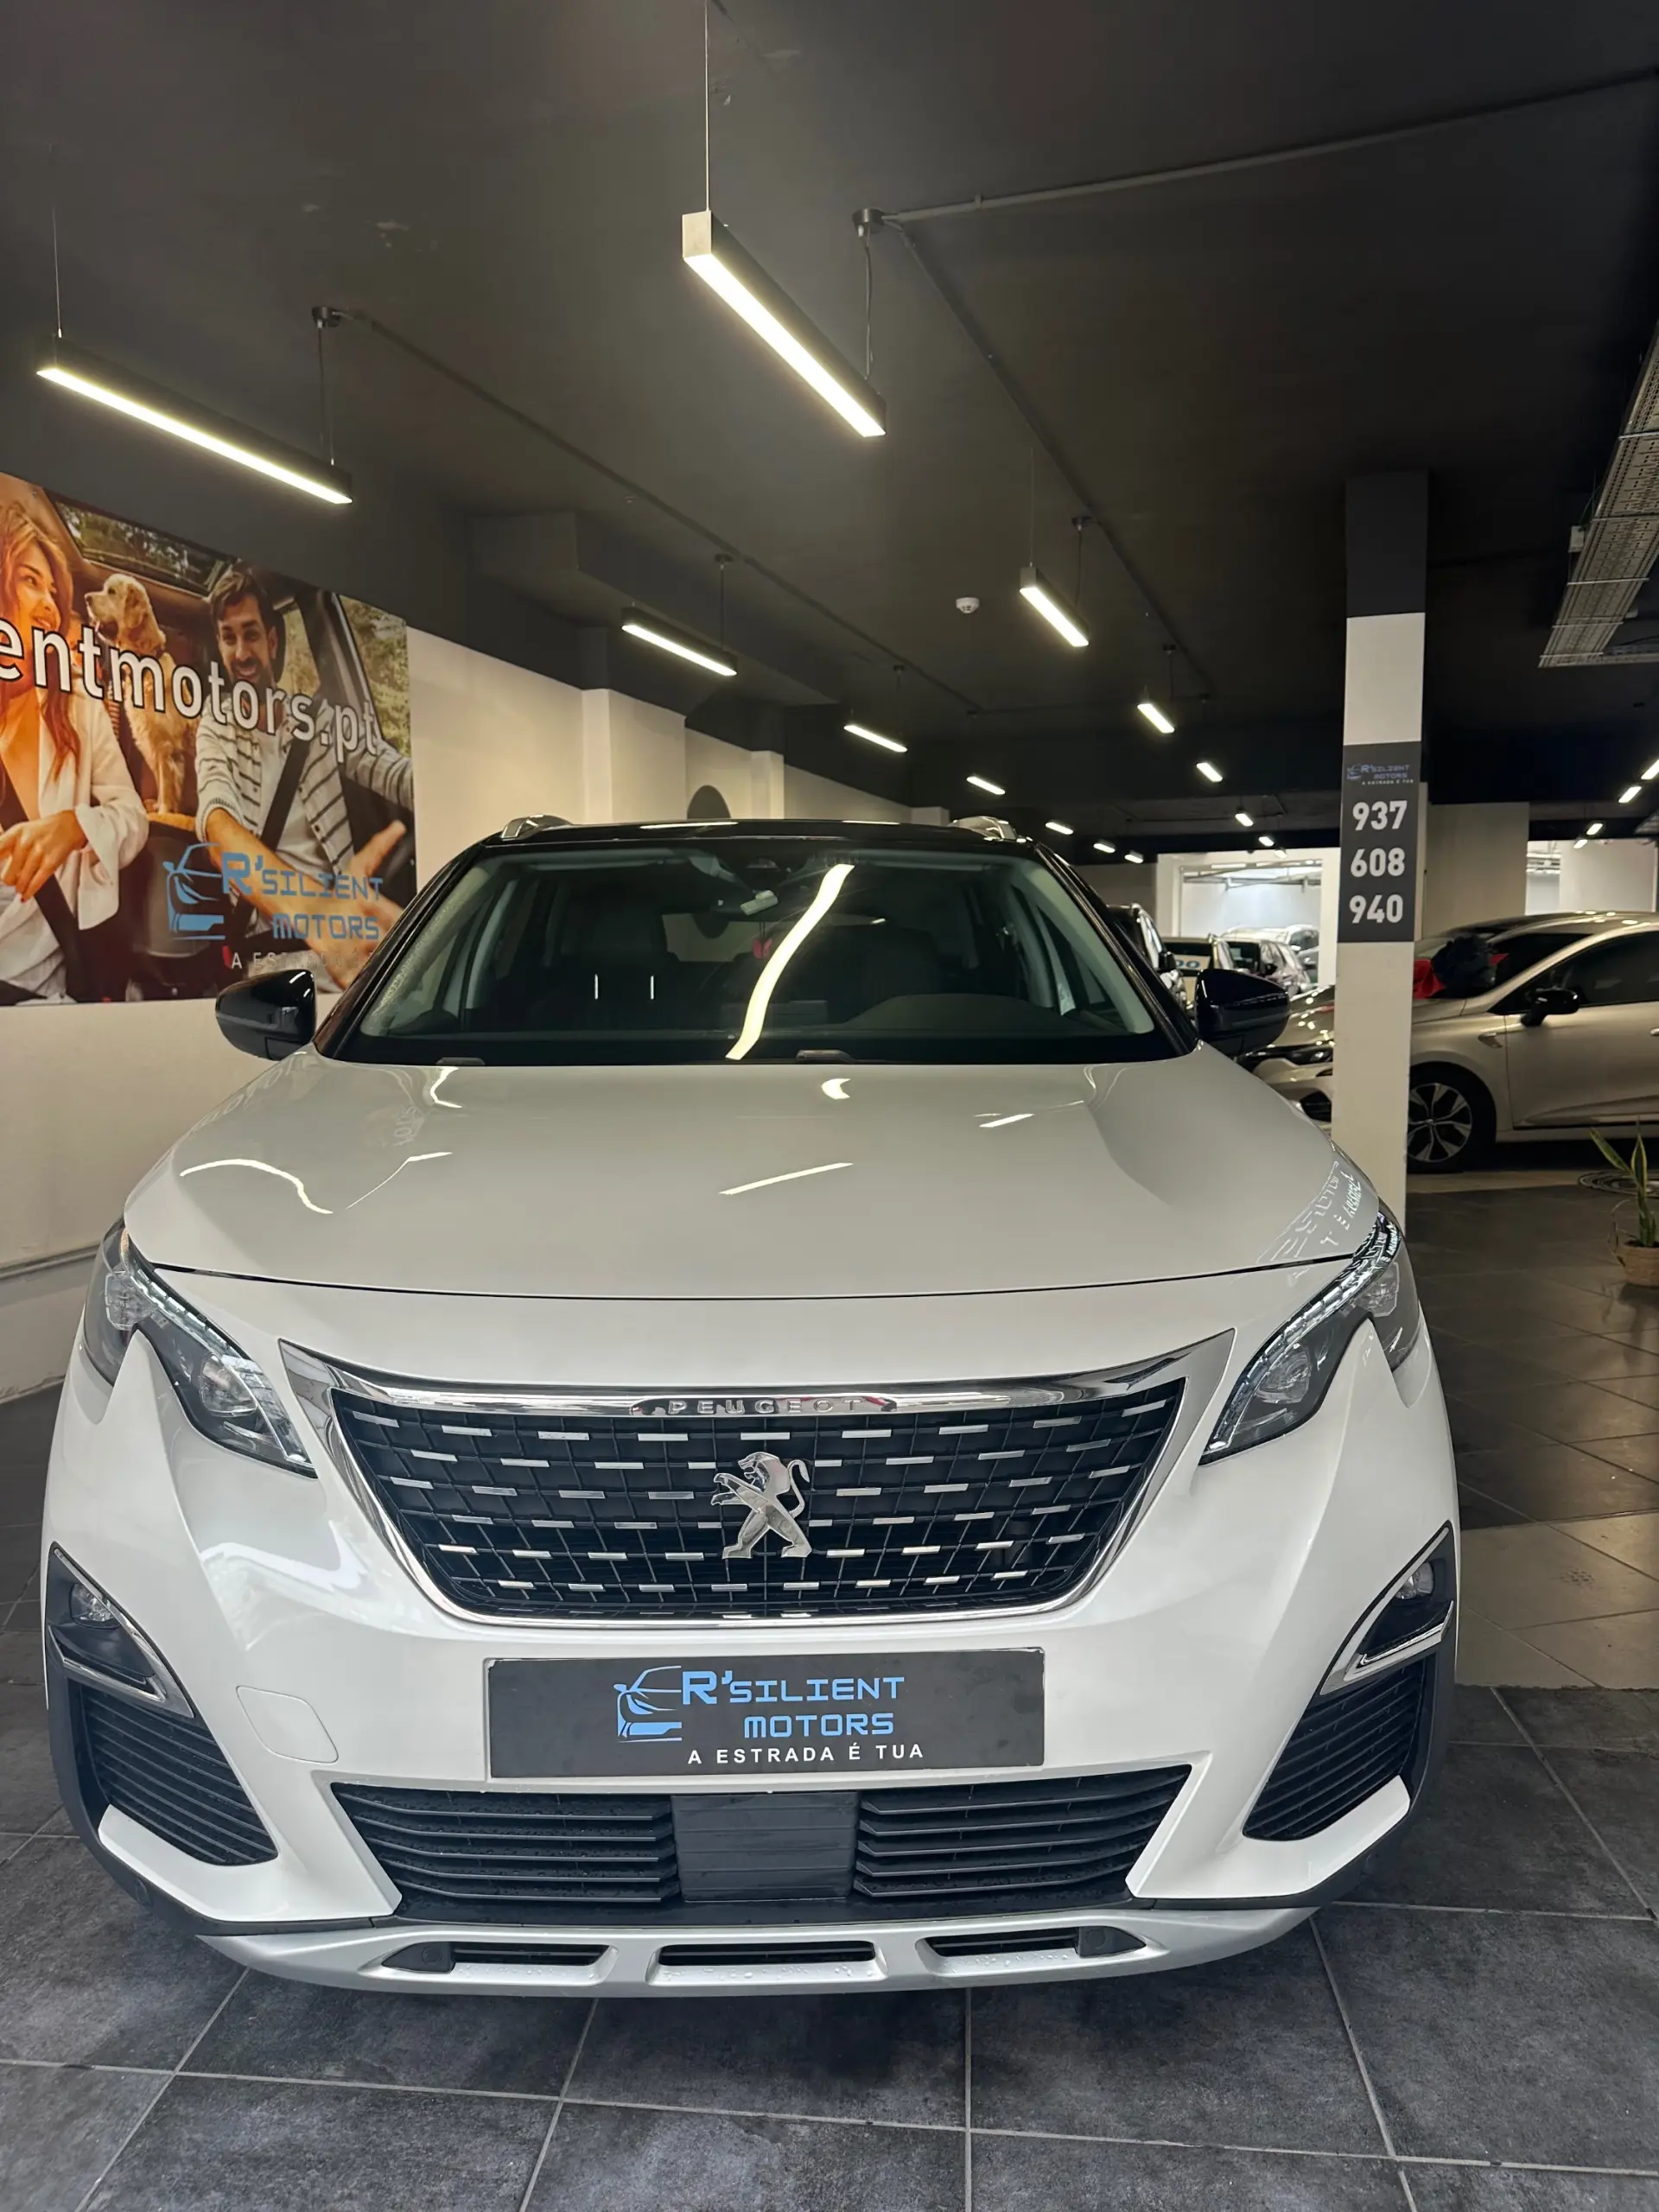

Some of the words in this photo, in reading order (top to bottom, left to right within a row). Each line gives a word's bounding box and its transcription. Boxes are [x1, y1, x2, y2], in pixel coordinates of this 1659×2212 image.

[1352, 800, 1408, 830] 937
[222, 852, 383, 900] R'SILIENT
[1351, 848, 1405, 877] 608
[1349, 894, 1403, 924] 940
[271, 912, 380, 940] MOTORS
[231, 951, 243, 969] A
[667, 1397, 865, 1415] PEUGEOT
[682, 1670, 905, 1705] R'SILIENT
[744, 1713, 894, 1738] MOTORS
[688, 1750, 702, 1764] A
[716, 1745, 835, 1764] ESTRADA
[849, 1742, 861, 1761] É
[875, 1744, 925, 1760] TUA
